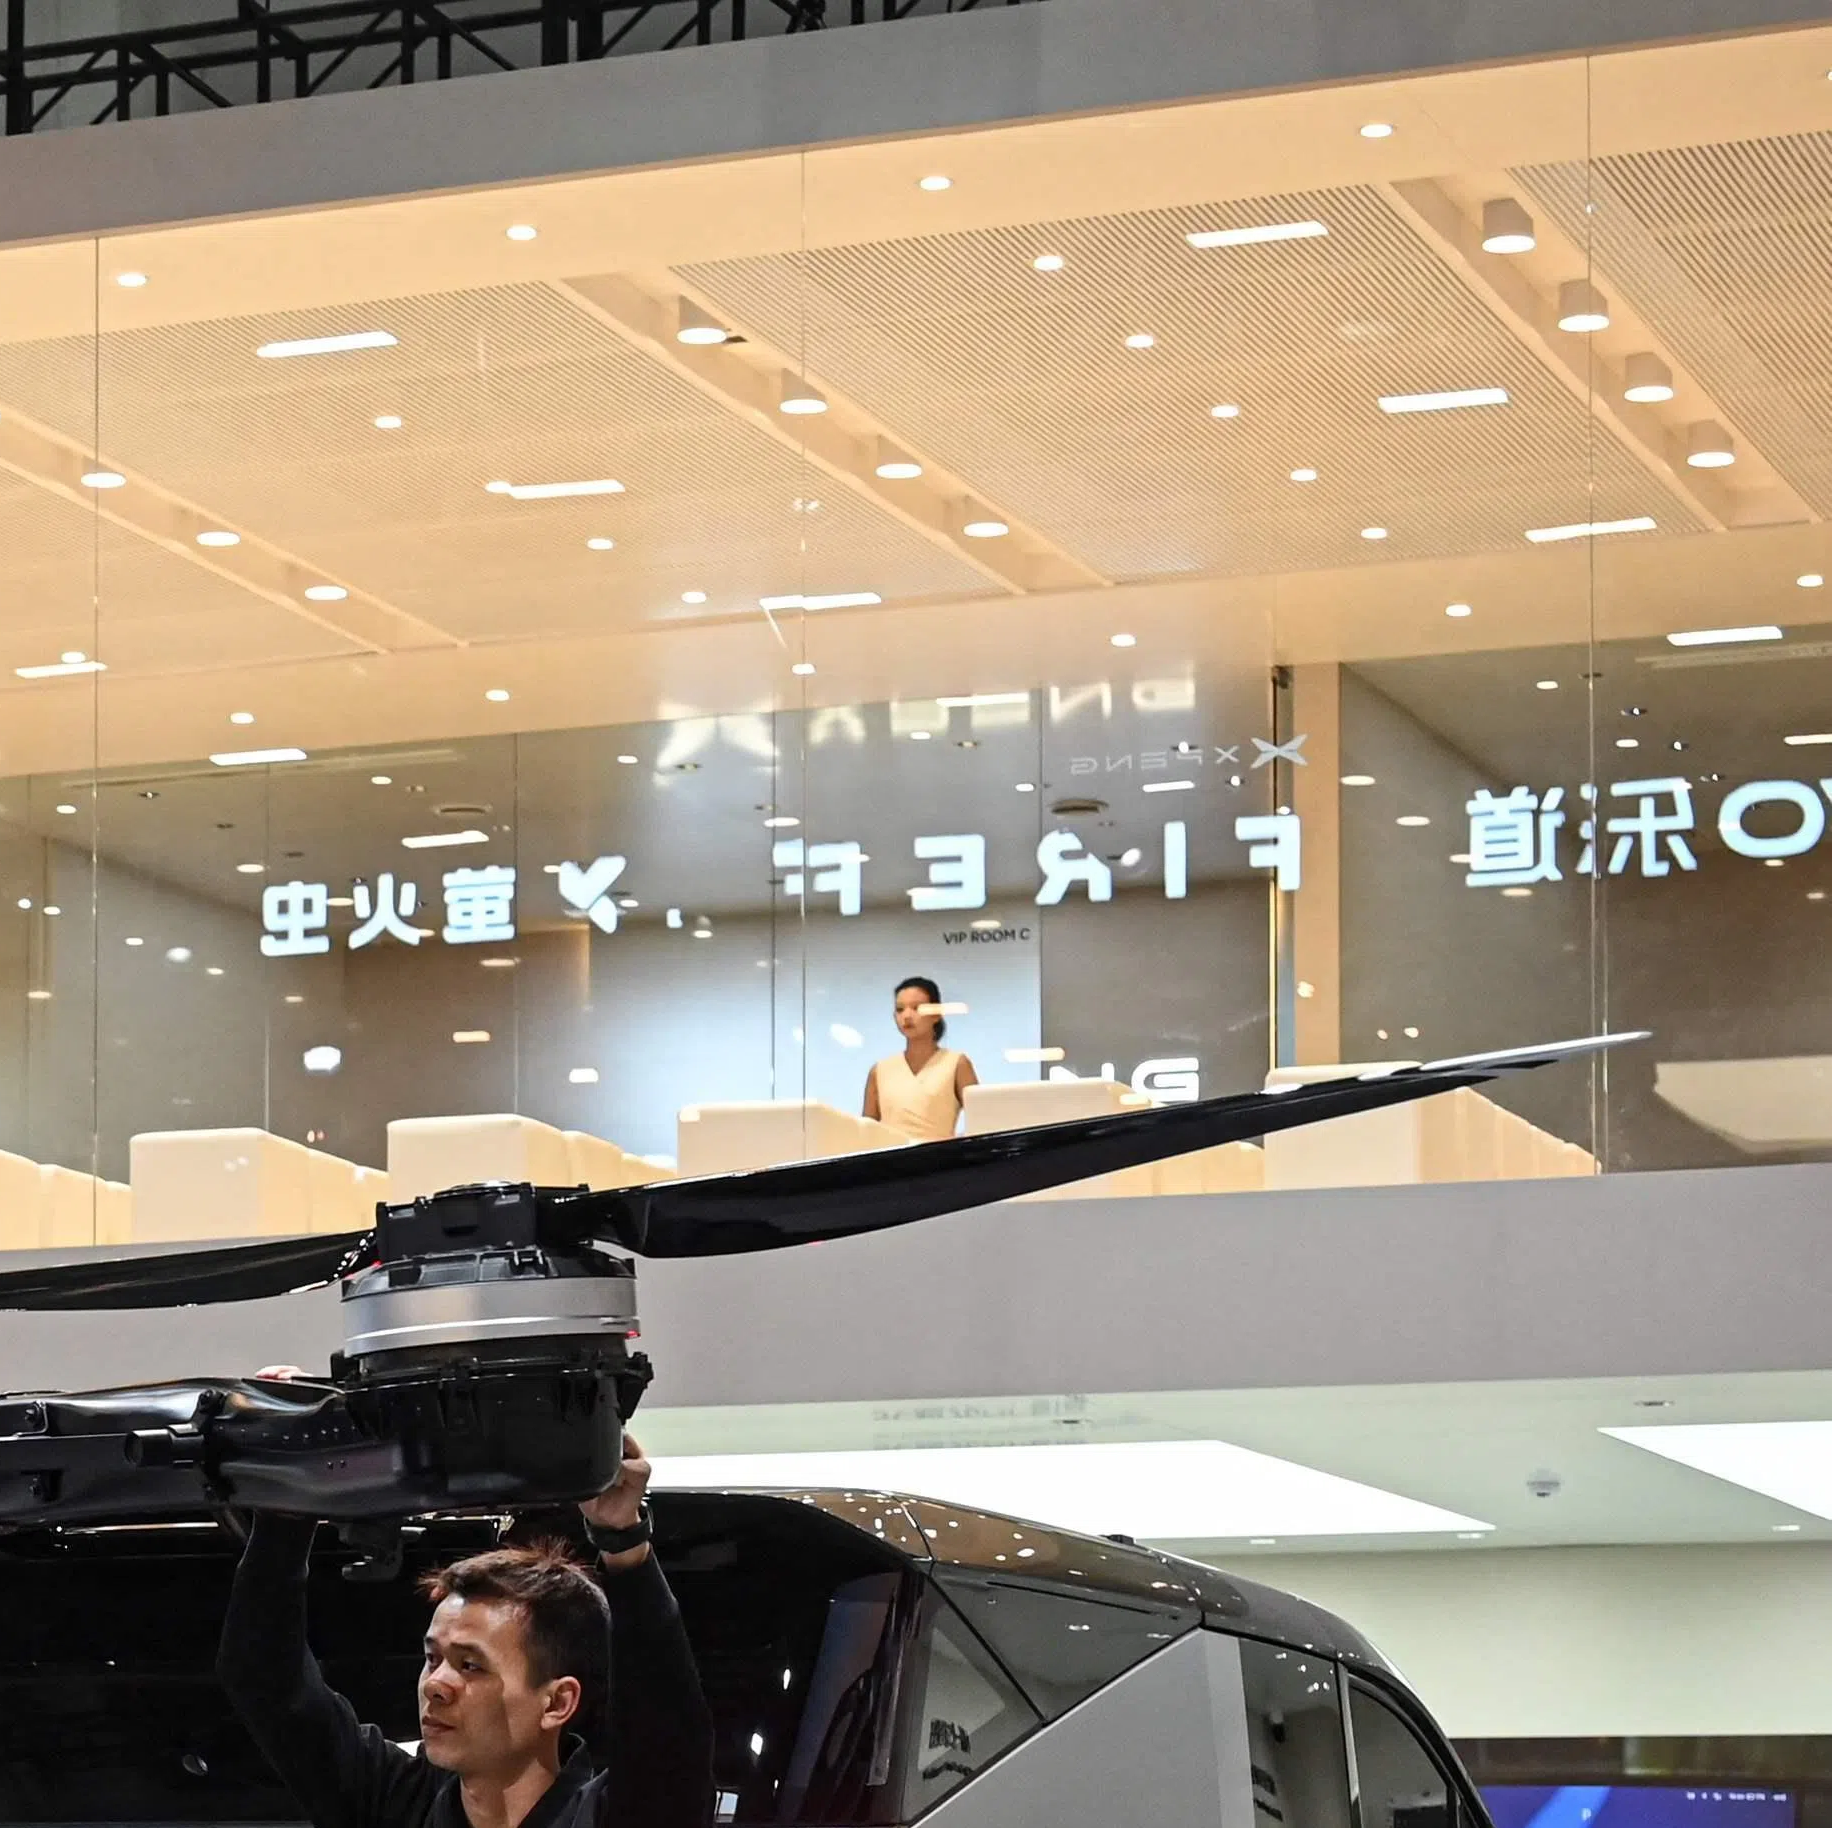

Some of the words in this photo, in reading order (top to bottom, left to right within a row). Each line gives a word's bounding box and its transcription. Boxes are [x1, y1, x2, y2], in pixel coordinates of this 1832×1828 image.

[942, 931, 968, 945] VIP
[970, 929, 1016, 944] ROOM
[1019, 927, 1031, 941] C
